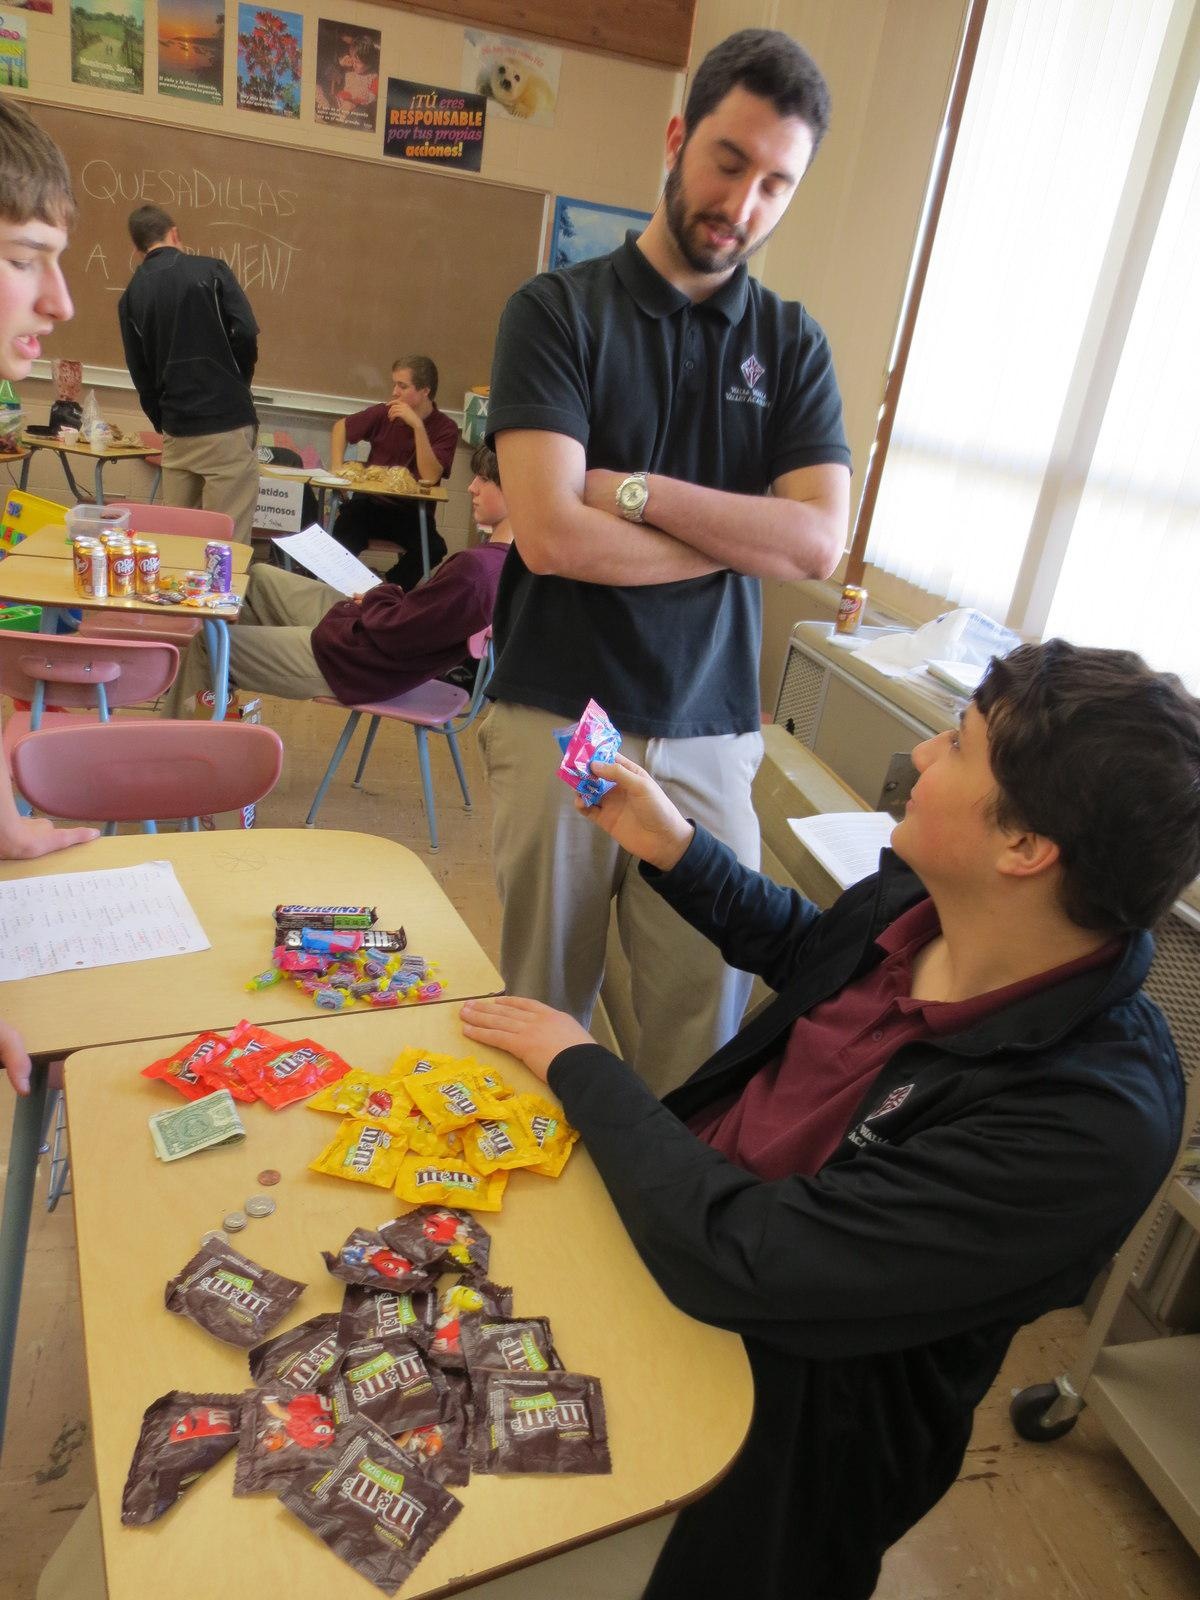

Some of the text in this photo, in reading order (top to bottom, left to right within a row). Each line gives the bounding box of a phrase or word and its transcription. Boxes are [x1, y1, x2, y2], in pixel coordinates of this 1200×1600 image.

[440, 98, 465, 109] eres
[390, 109, 483, 126] RESPONSABLE
[386, 126, 482, 144] por tus propias
[405, 141, 464, 158] acciones!
[82, 159, 299, 217] QUESADILLAS
